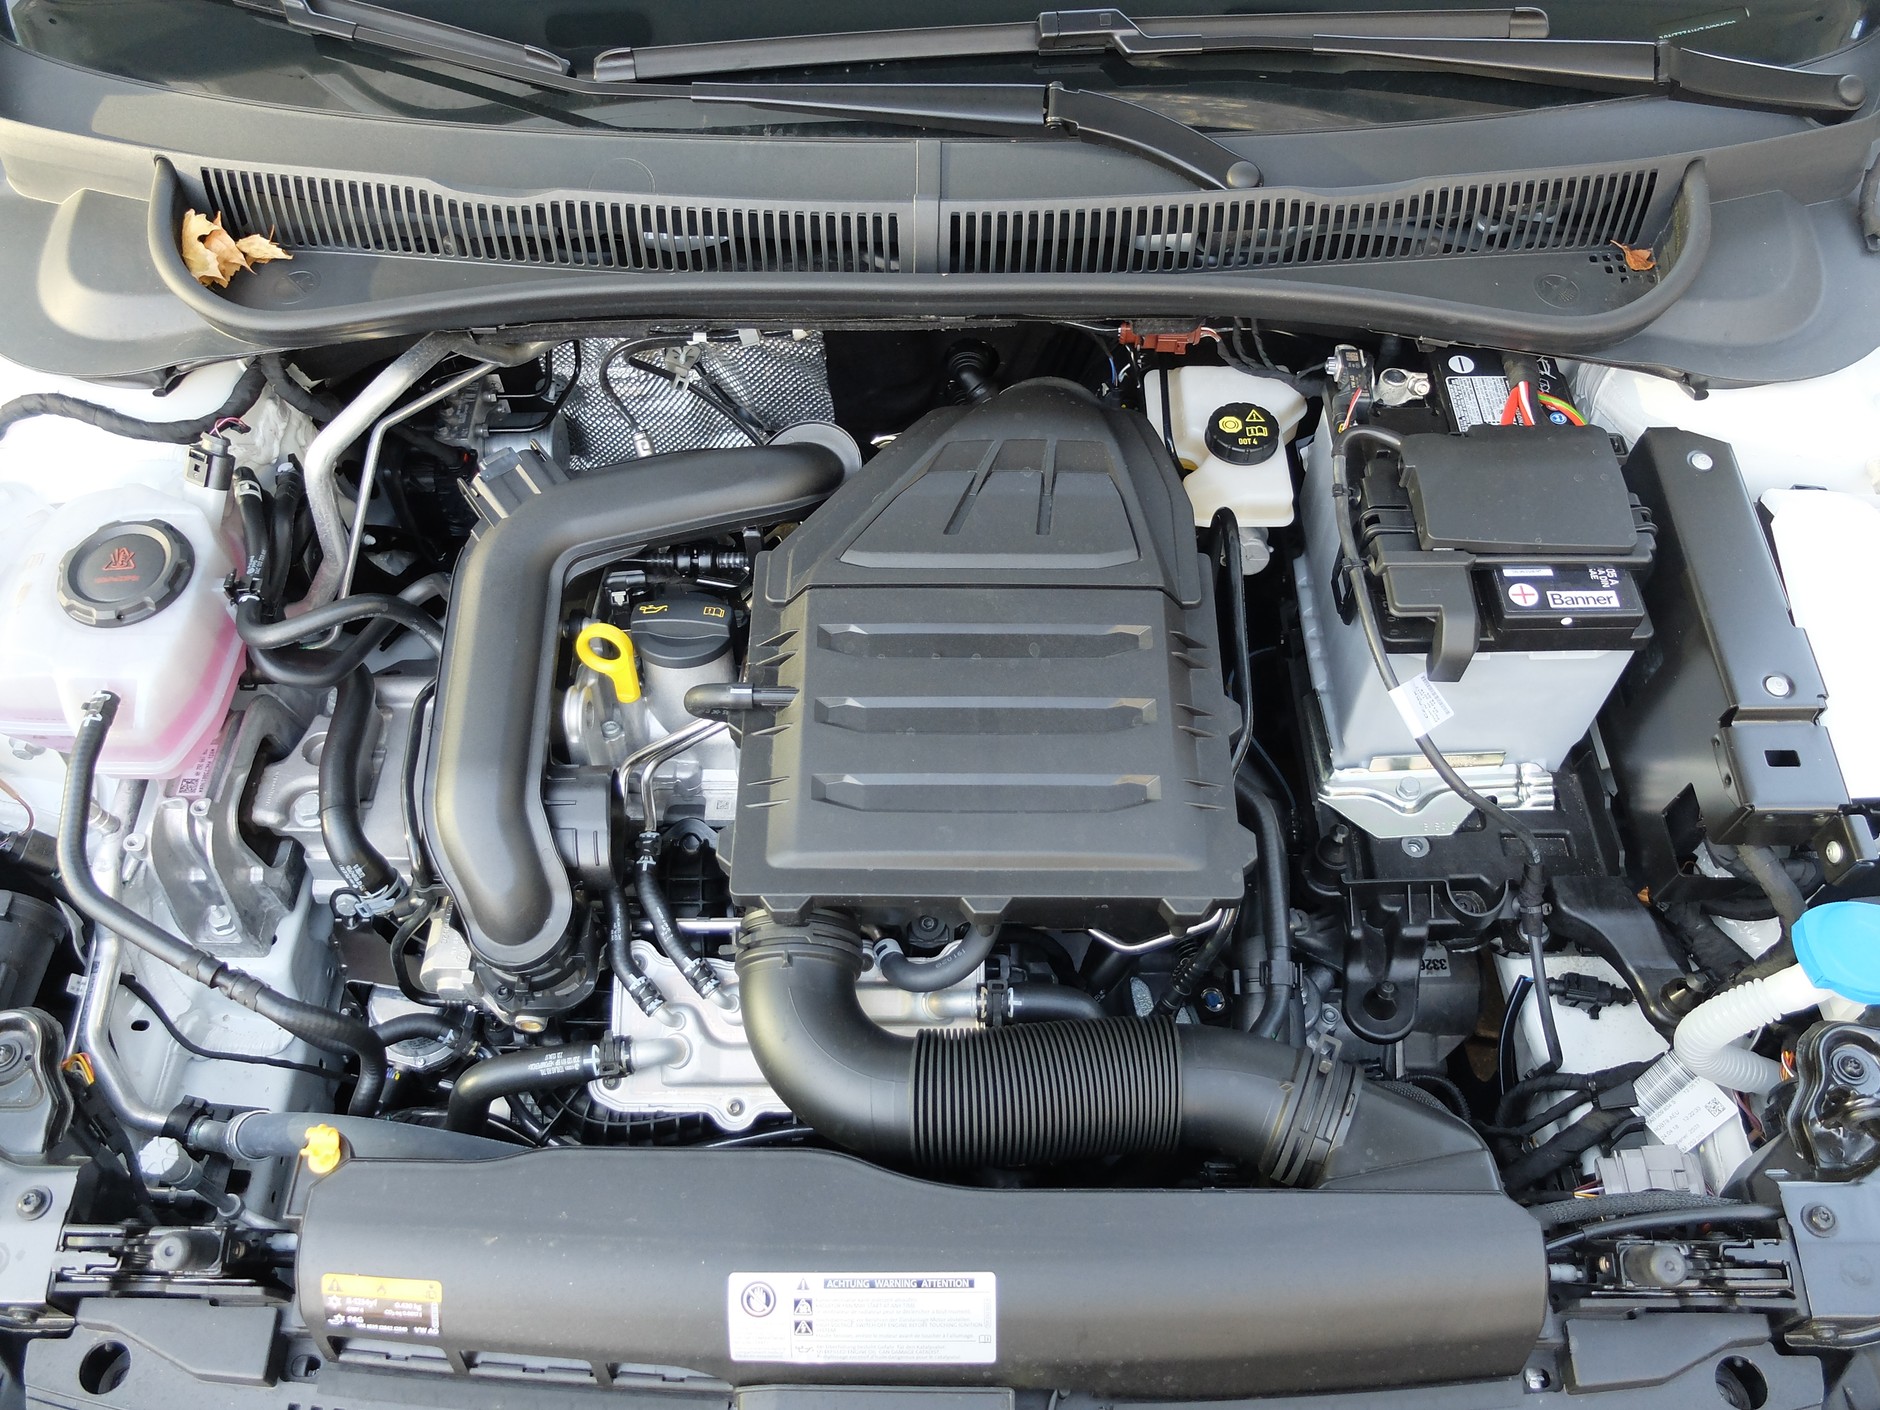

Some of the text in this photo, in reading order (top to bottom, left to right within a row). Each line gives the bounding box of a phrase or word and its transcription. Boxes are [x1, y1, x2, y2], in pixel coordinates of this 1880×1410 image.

[1600, 575, 1611, 588] DIN
[1550, 593, 1613, 606] Banner
[826, 1279, 969, 1288] ACHTUNG WARNING ATTENTION
[346, 1315, 364, 1323] PAG
